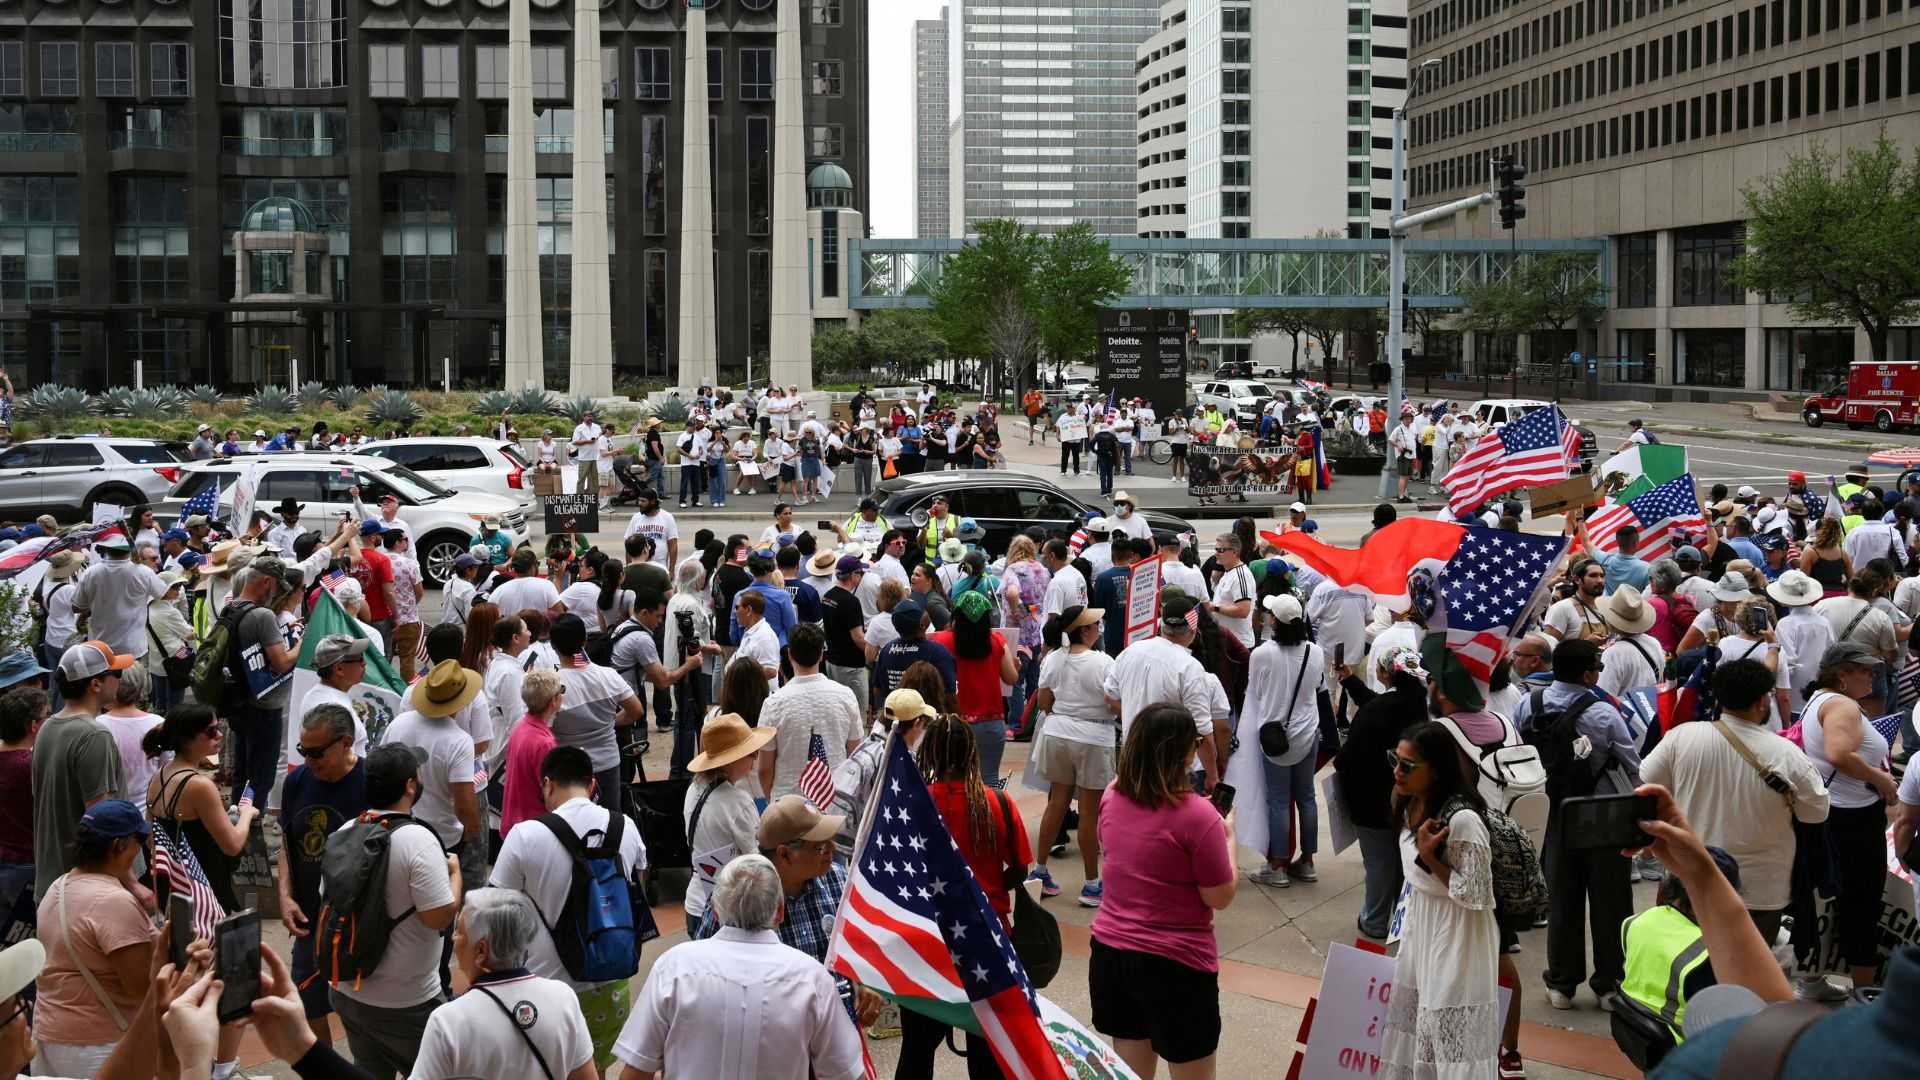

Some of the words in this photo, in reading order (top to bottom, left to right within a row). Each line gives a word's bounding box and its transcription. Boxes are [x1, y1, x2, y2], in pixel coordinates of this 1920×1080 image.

[1108, 337, 1142, 345] Deloitte.
[1848, 406, 1858, 414] 91
[545, 495, 582, 504] DISMANTLE
[583, 494, 597, 504] THE
[554, 504, 588, 514] OLIGARCHY
